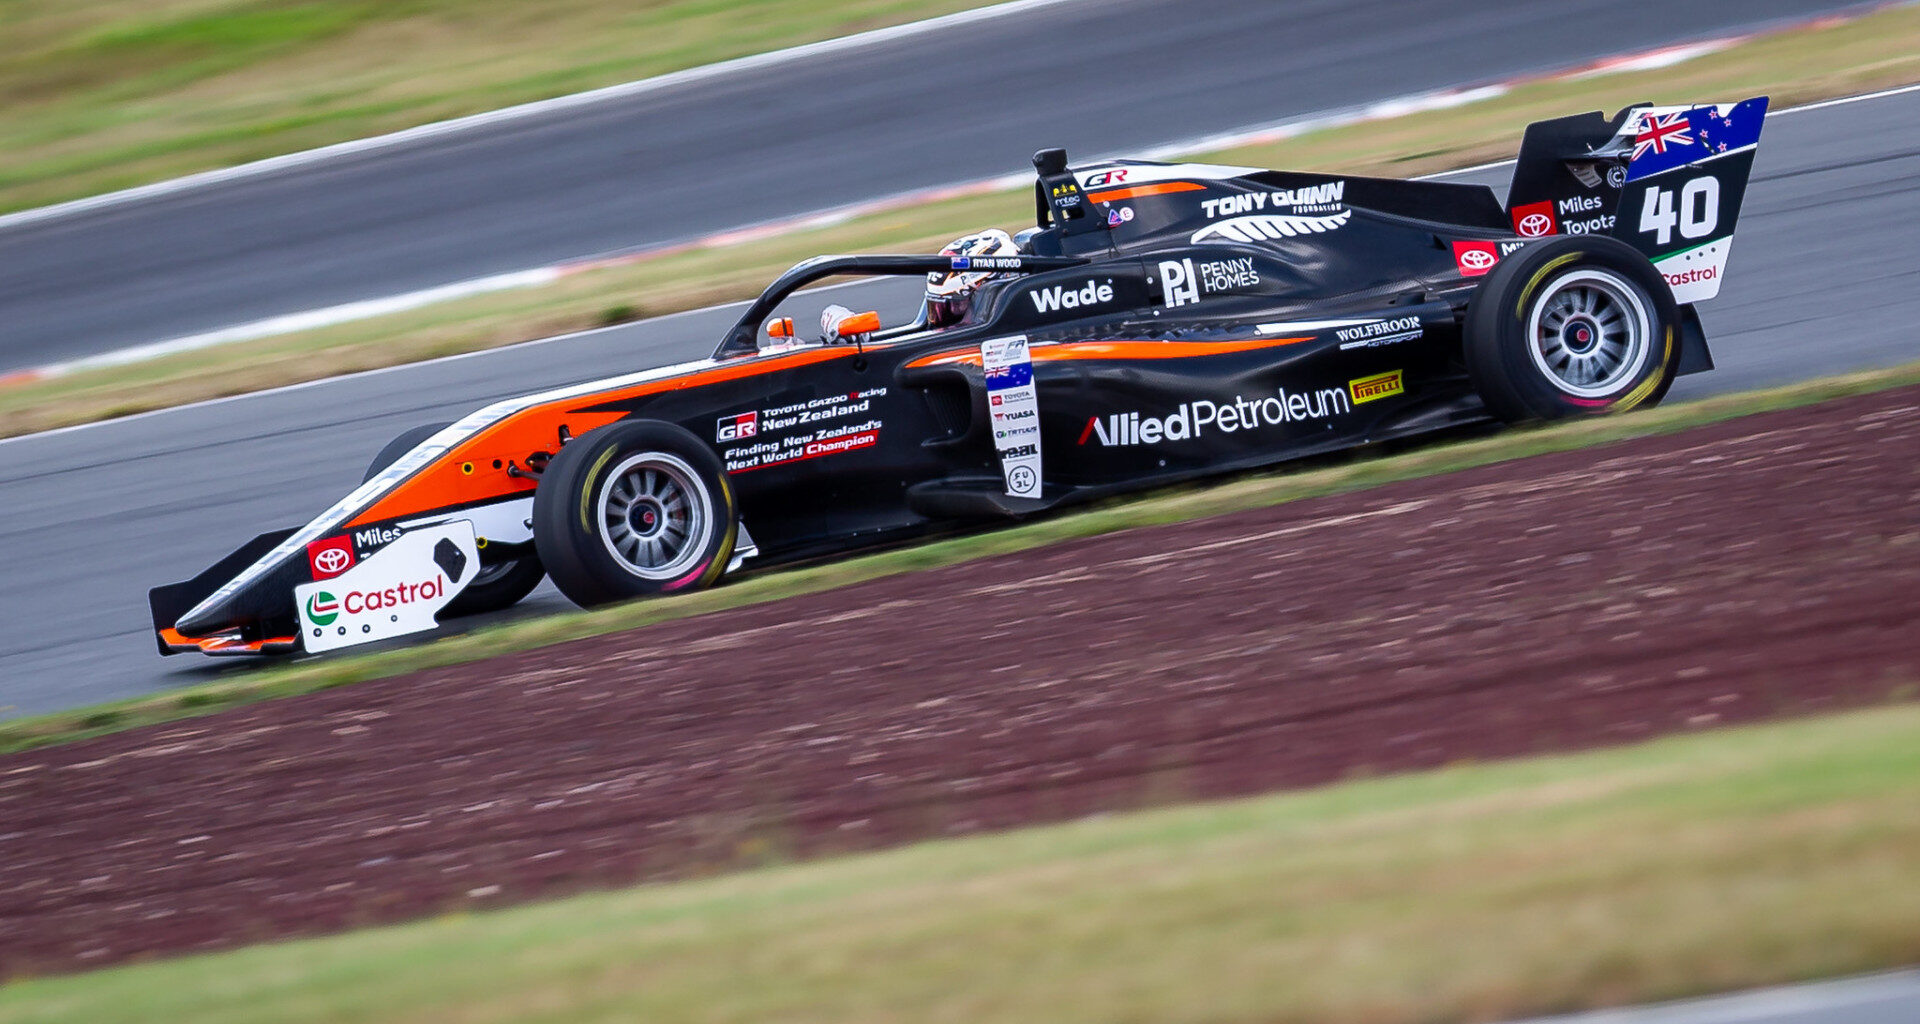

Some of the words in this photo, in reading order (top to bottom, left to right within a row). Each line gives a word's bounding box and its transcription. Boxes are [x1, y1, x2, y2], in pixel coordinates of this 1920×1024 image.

[1083, 169, 1128, 188] GR
[1201, 192, 1267, 219] TONY
[1271, 181, 1345, 207] QUINN
[1292, 202, 1342, 214] FOUNDATION
[1558, 195, 1602, 215] Miles
[1639, 175, 1720, 245] 40
[1562, 214, 1617, 235] Toyota
[972, 258, 995, 269] RYAN
[996, 258, 1021, 269] WOOD
[1200, 256, 1253, 278] PENNY
[1204, 270, 1260, 292] HOMES
[1030, 279, 1114, 313] Wade
[1336, 316, 1421, 341] WOLFBROOK
[1004, 391, 1030, 400] TOYOTA
[1352, 374, 1400, 399] PIRELLI
[762, 402, 807, 418] TOYOTA
[808, 394, 848, 409] GAZOO
[762, 417, 801, 432] New
[799, 400, 870, 424] Zealand
[1005, 410, 1036, 421] YUASA
[719, 420, 755, 441] GR
[725, 440, 780, 460] Finding
[784, 434, 813, 448] New
[816, 419, 883, 441] Zealand's
[726, 456, 760, 471] Next
[762, 446, 804, 464] World
[806, 434, 875, 454] Champion
[355, 527, 402, 548] Miles
[344, 573, 444, 615] Castrol
